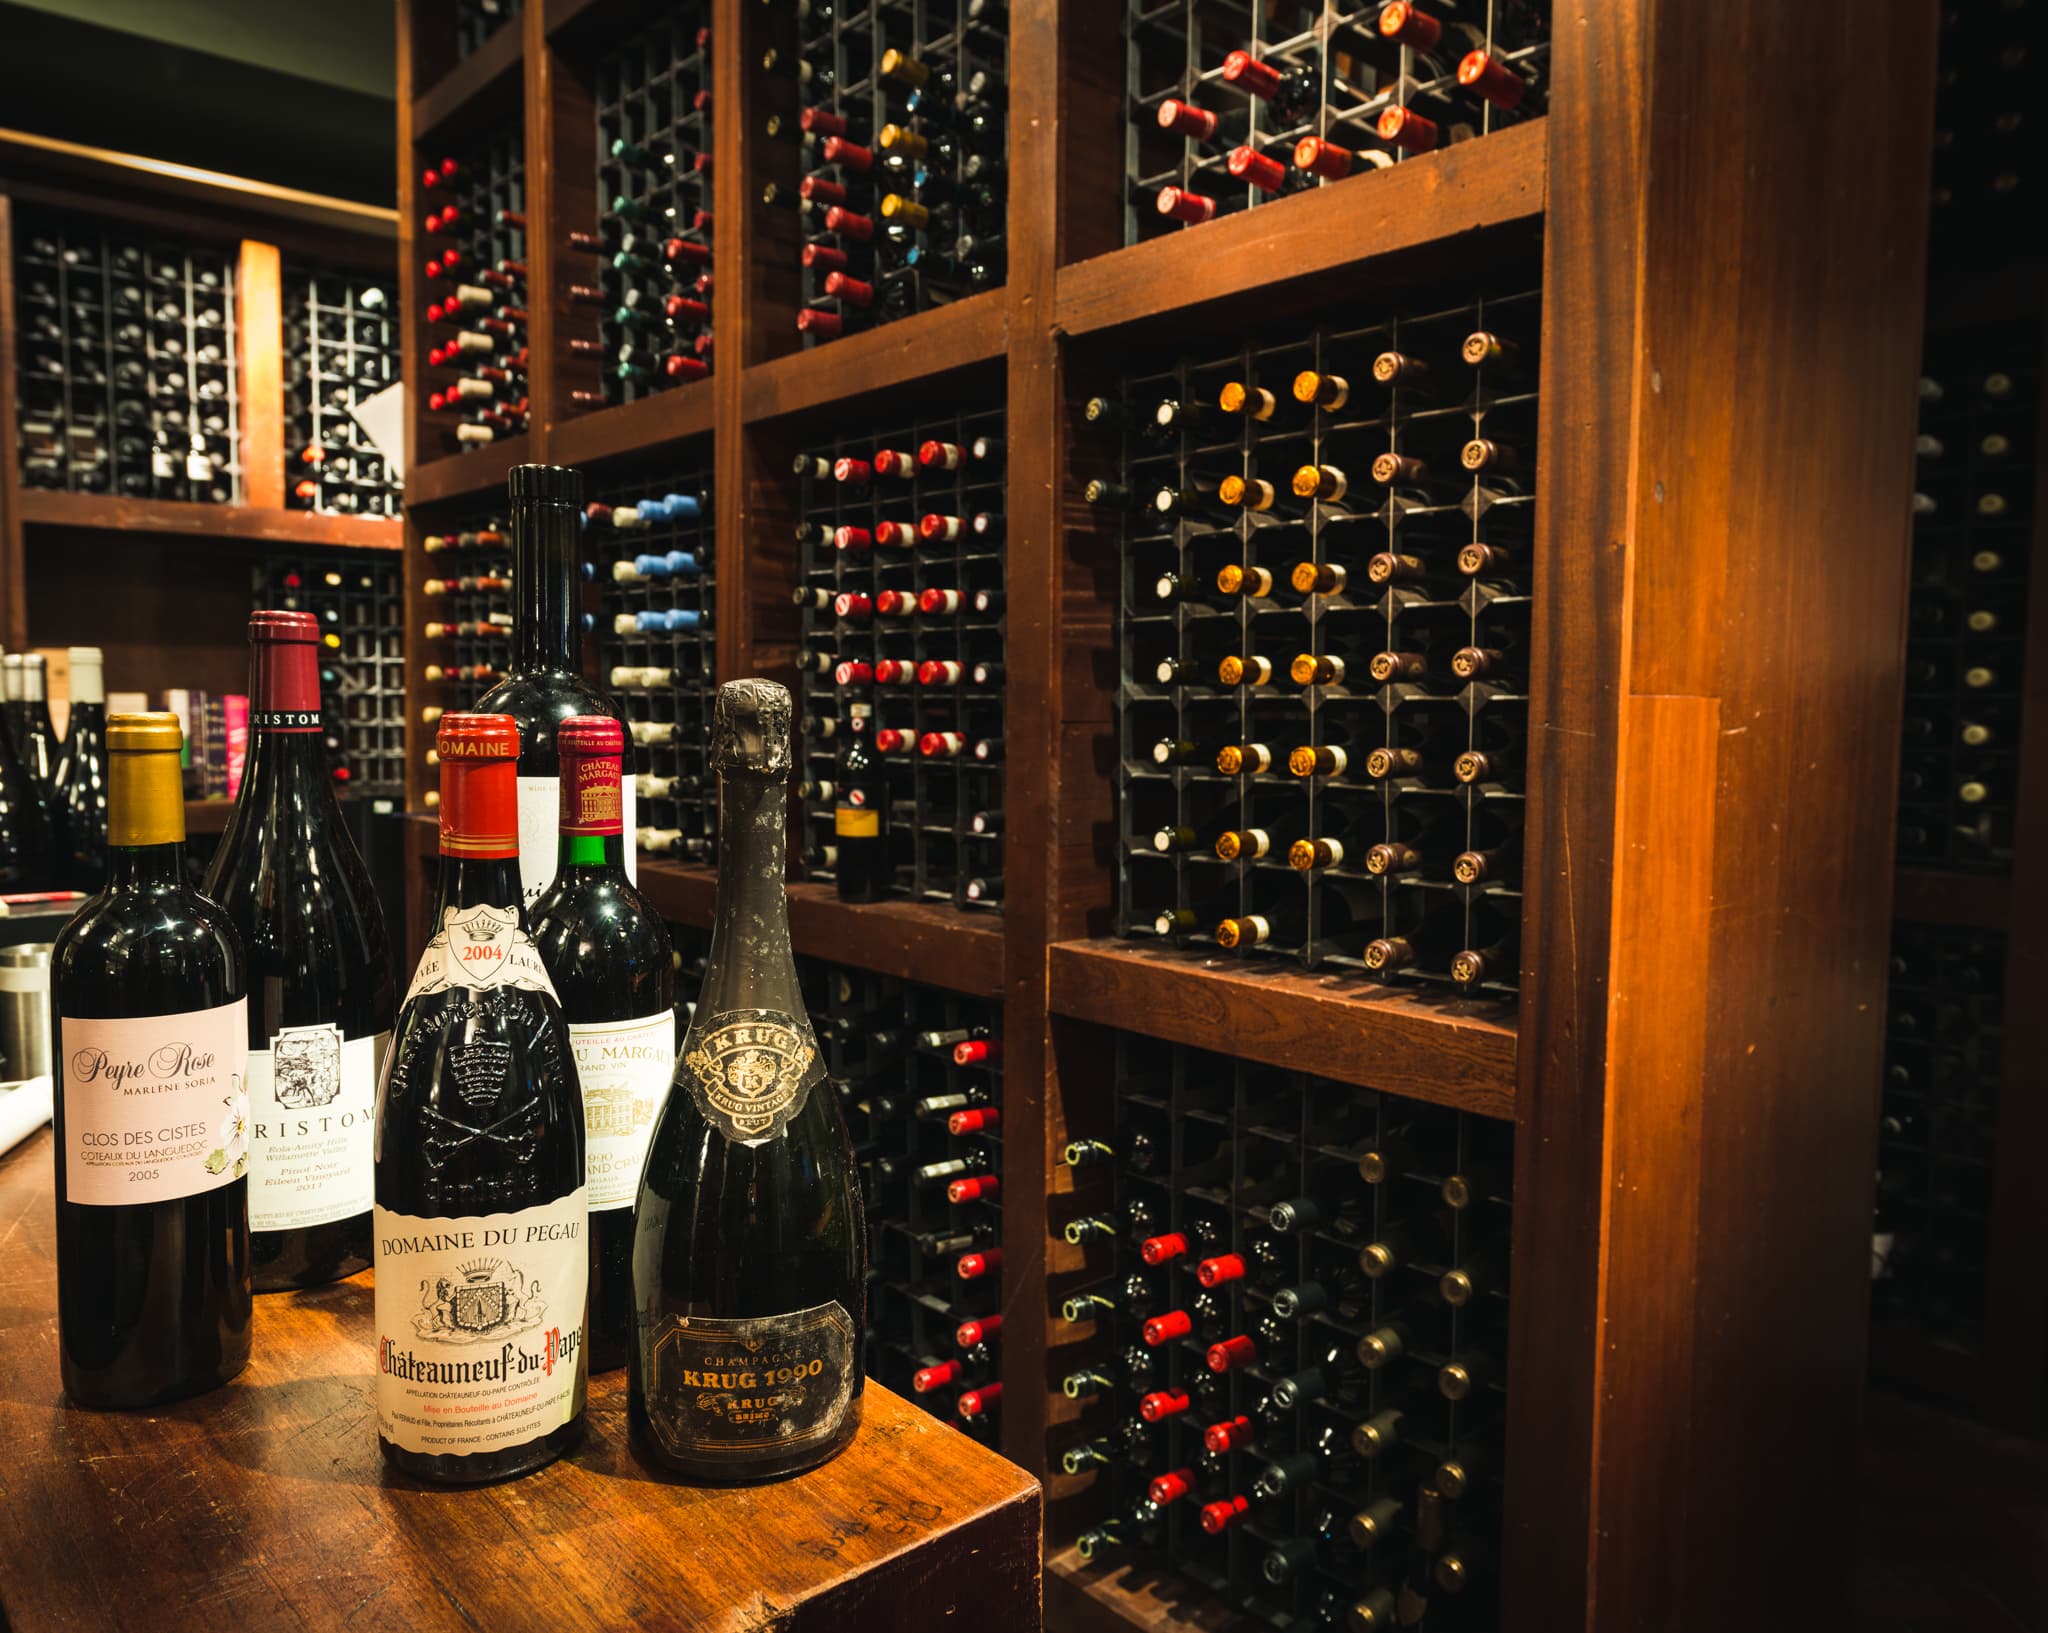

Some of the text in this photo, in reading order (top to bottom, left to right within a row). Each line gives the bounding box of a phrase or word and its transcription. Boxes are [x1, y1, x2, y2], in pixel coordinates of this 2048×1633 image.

[250, 713, 320, 725] RISTOM
[440, 740, 510, 756] OMAINE
[463, 943, 502, 961] 2004
[713, 1028, 788, 1052] KRUG
[72, 1041, 215, 1090] Peyre Rose
[579, 1061, 627, 1072] RAND VIN
[185, 1076, 216, 1090] SORIA
[715, 1089, 791, 1112] KRUG VINTAGE
[82, 1121, 206, 1147] CLOS DES CISTES
[81, 1150, 123, 1161] COTEAUX
[126, 1149, 141, 1160] DU
[144, 1139, 208, 1159] LANGUEDOC
[128, 1169, 159, 1182] 2005
[382, 1221, 580, 1256] DOMAINE DU PEGAU
[704, 1349, 805, 1367] CHAMPAGNE
[683, 1358, 823, 1390] KRUG 1990
[424, 1391, 538, 1415] Mise en Bouteille au Domaine
[727, 1395, 780, 1410] KRUG
[421, 1420, 541, 1446] PRODUCT OF FRANCE CONTAINS SULFITES
